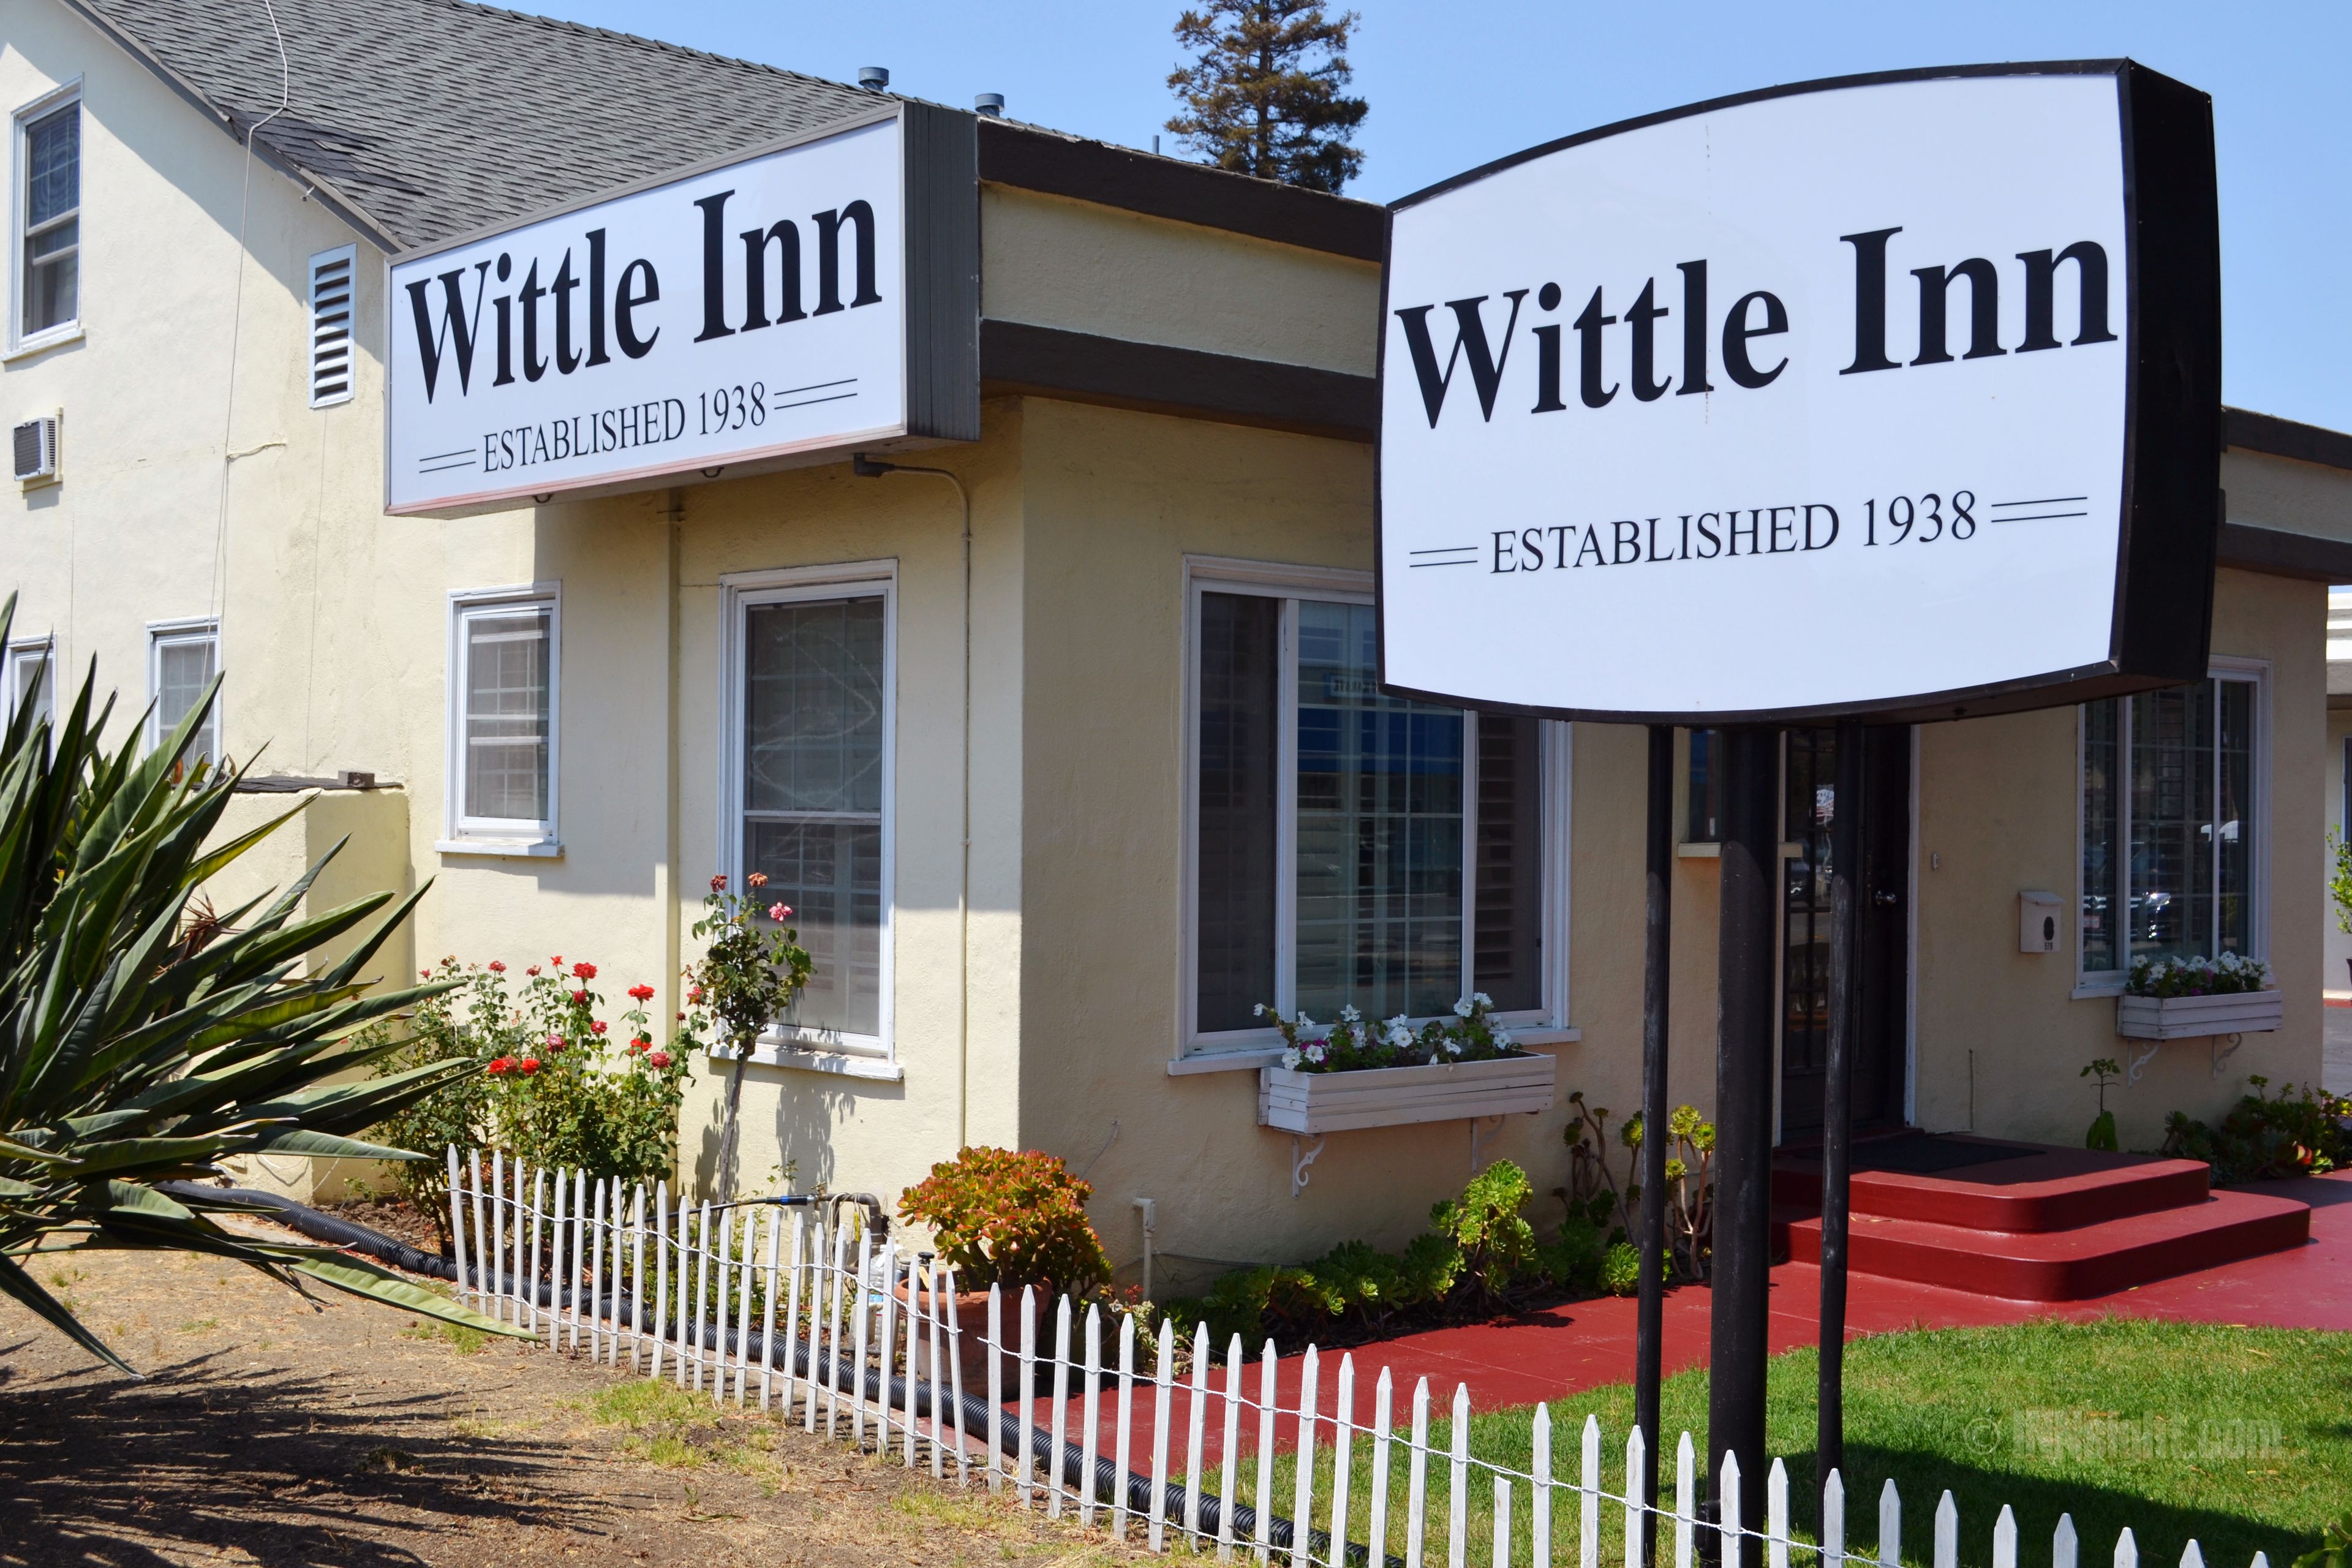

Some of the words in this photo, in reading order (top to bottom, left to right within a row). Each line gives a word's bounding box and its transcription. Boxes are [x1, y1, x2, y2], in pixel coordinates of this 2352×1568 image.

[405, 227, 660, 404] Wittle
[693, 189, 883, 344] Inn
[1393, 258, 1789, 429] Wittle
[1839, 226, 2118, 375] Inn
[484, 398, 685, 473] ESTABLISHED
[699, 382, 766, 435] 1938
[1490, 504, 1839, 574] ESTABLISHED
[1863, 490, 1976, 546] 1938
